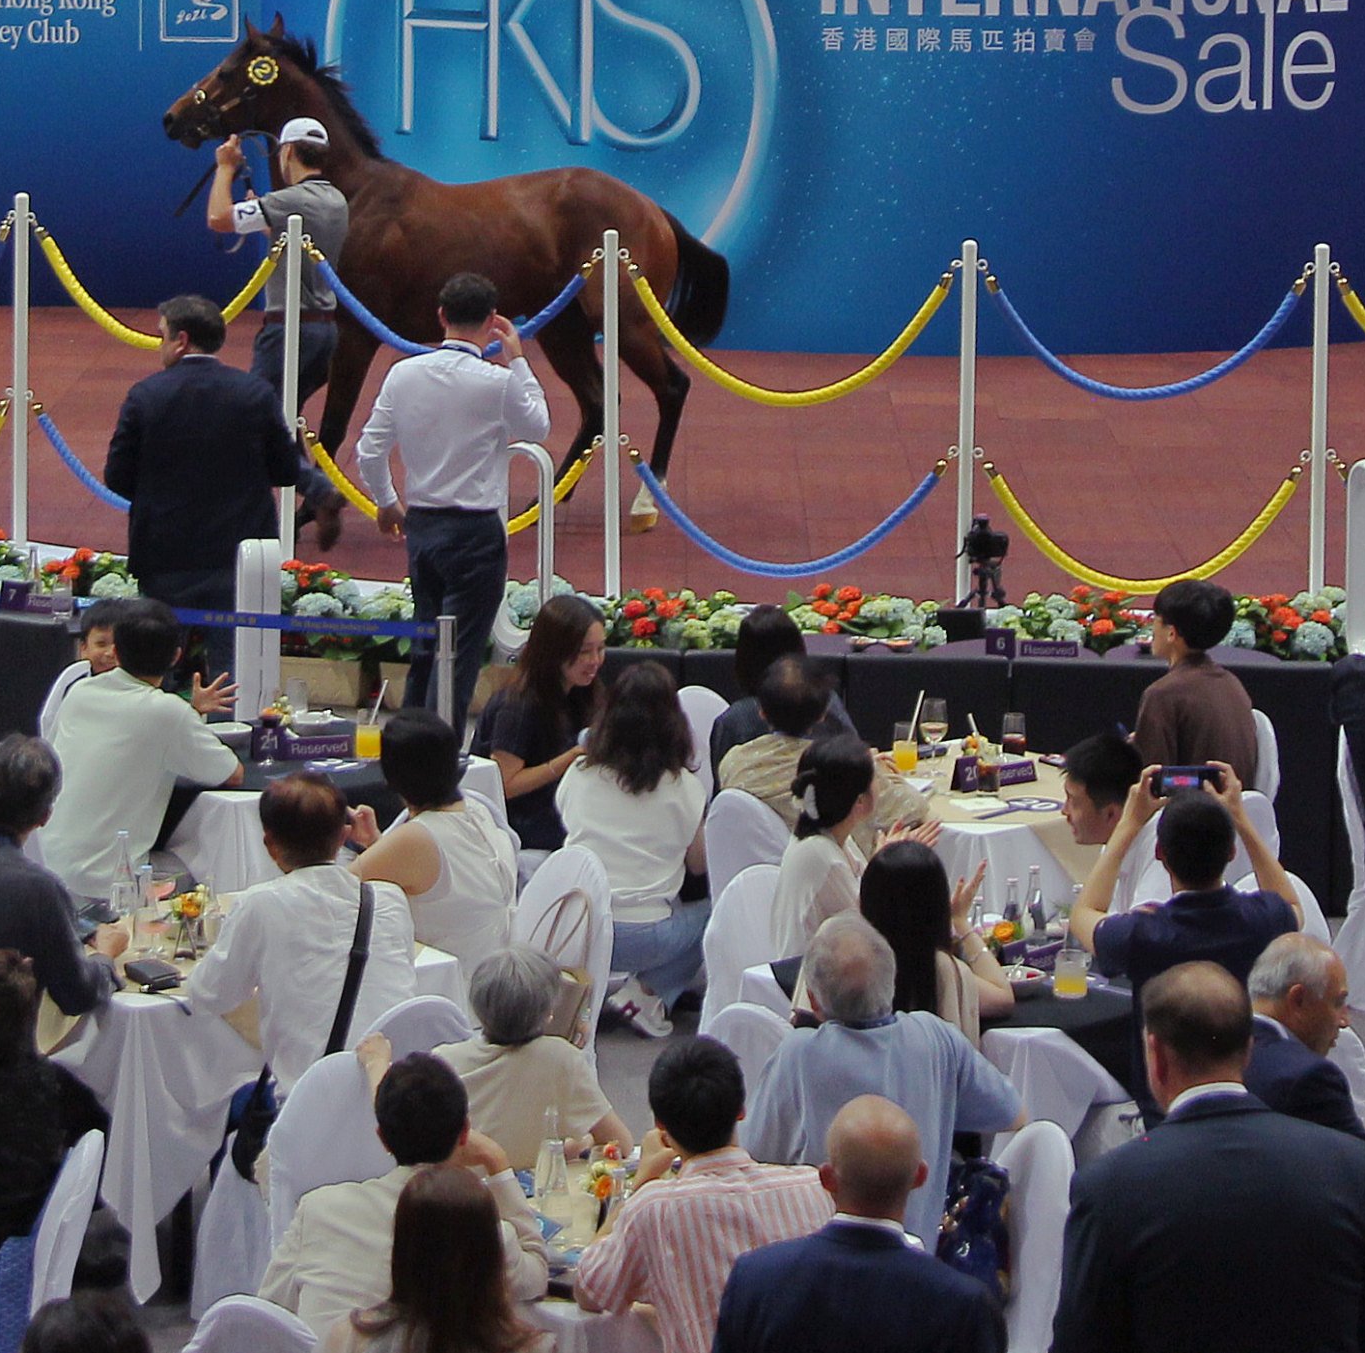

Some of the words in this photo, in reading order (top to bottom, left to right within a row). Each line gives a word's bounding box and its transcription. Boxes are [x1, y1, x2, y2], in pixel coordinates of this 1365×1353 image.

[27, 21, 80, 44] Club
[821, 26, 1097, 53] 香港國際馬匹拍賣會
[1111, 7, 1336, 114] Sale
[237, 205, 257, 220] 2
[996, 637, 1006, 650] 6
[291, 740, 349, 755] Reserved
